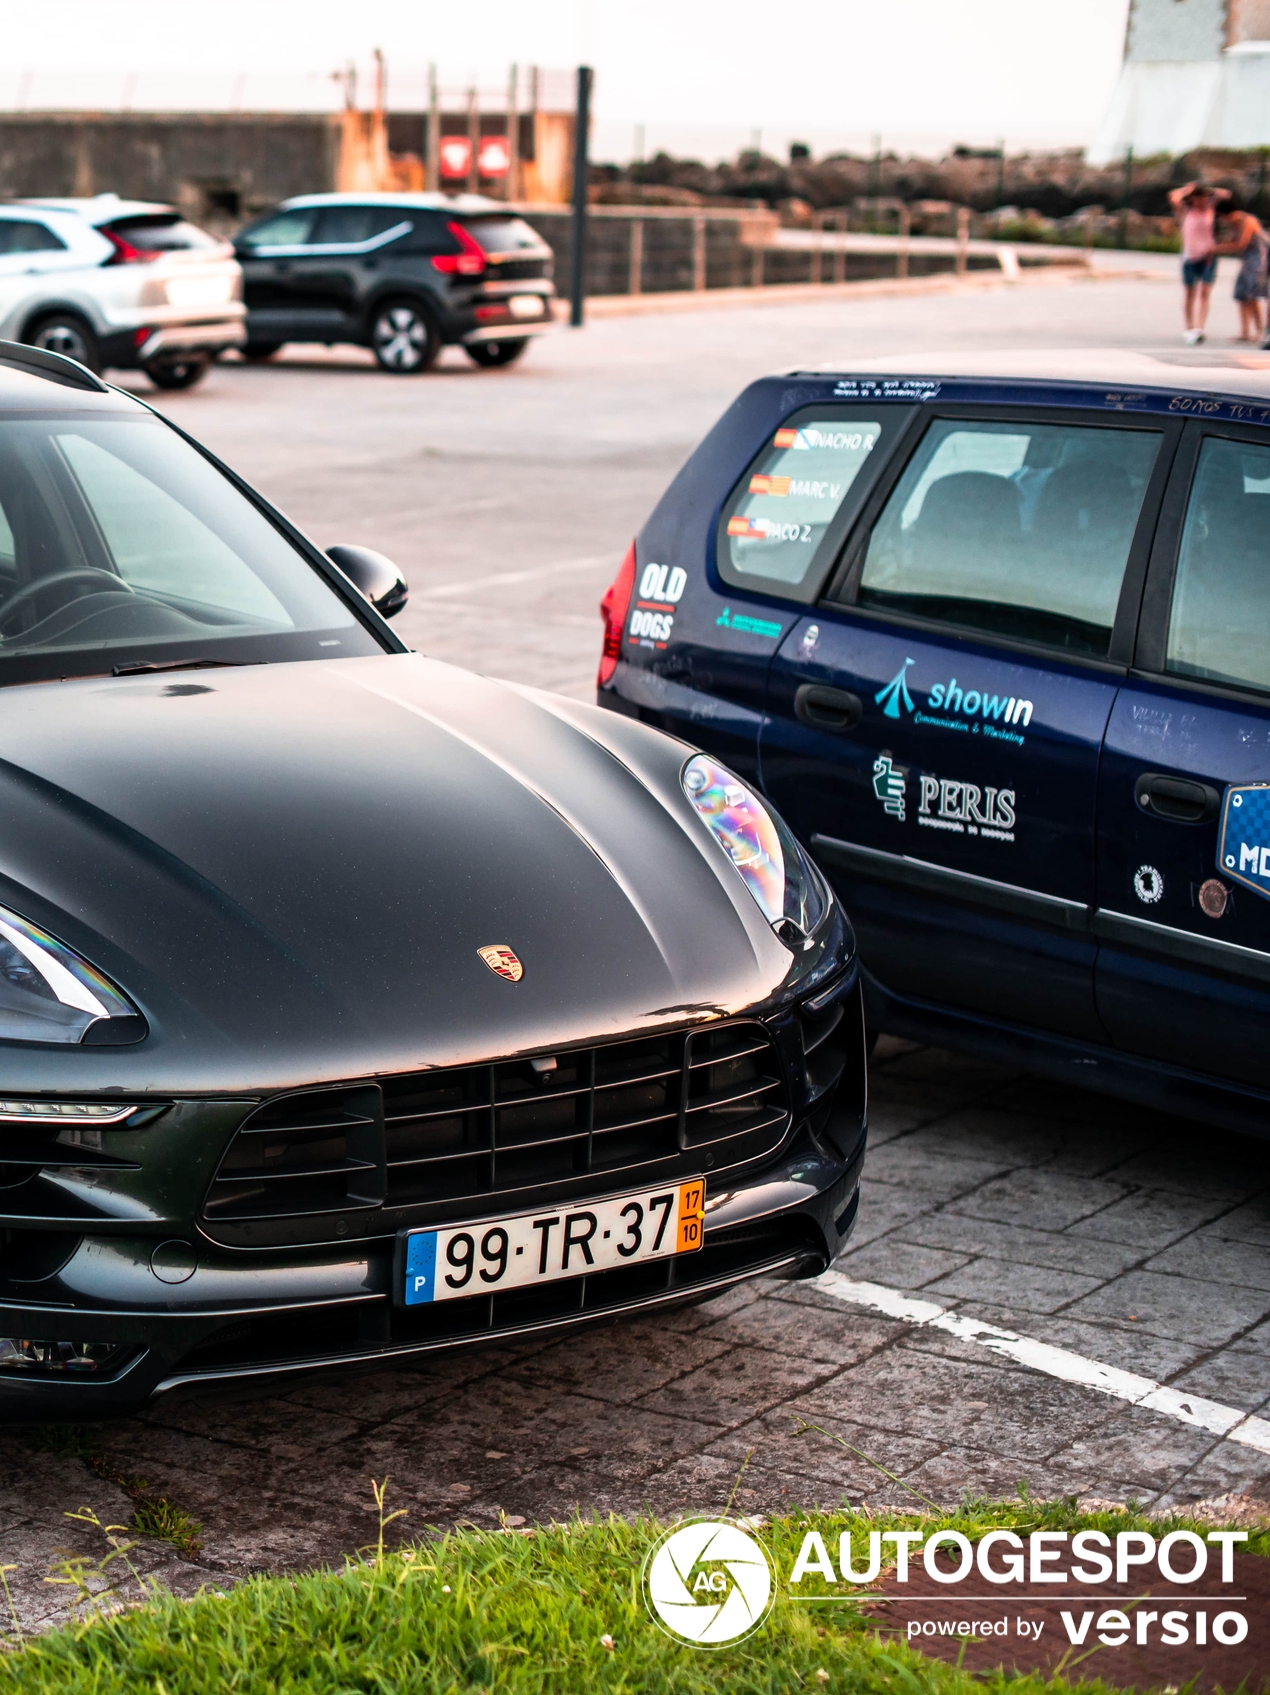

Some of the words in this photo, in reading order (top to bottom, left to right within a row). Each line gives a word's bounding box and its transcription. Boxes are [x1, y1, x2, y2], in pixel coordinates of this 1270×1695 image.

[814, 432, 862, 449] NACHO
[789, 479, 829, 497] MARC
[766, 522, 800, 541] PACO
[639, 563, 687, 602] OLD
[629, 610, 674, 641] DOGS
[918, 775, 1017, 829] PERIS
[685, 1190, 700, 1210] 17
[683, 1223, 698, 1243] 10
[414, 1276, 426, 1292] P
